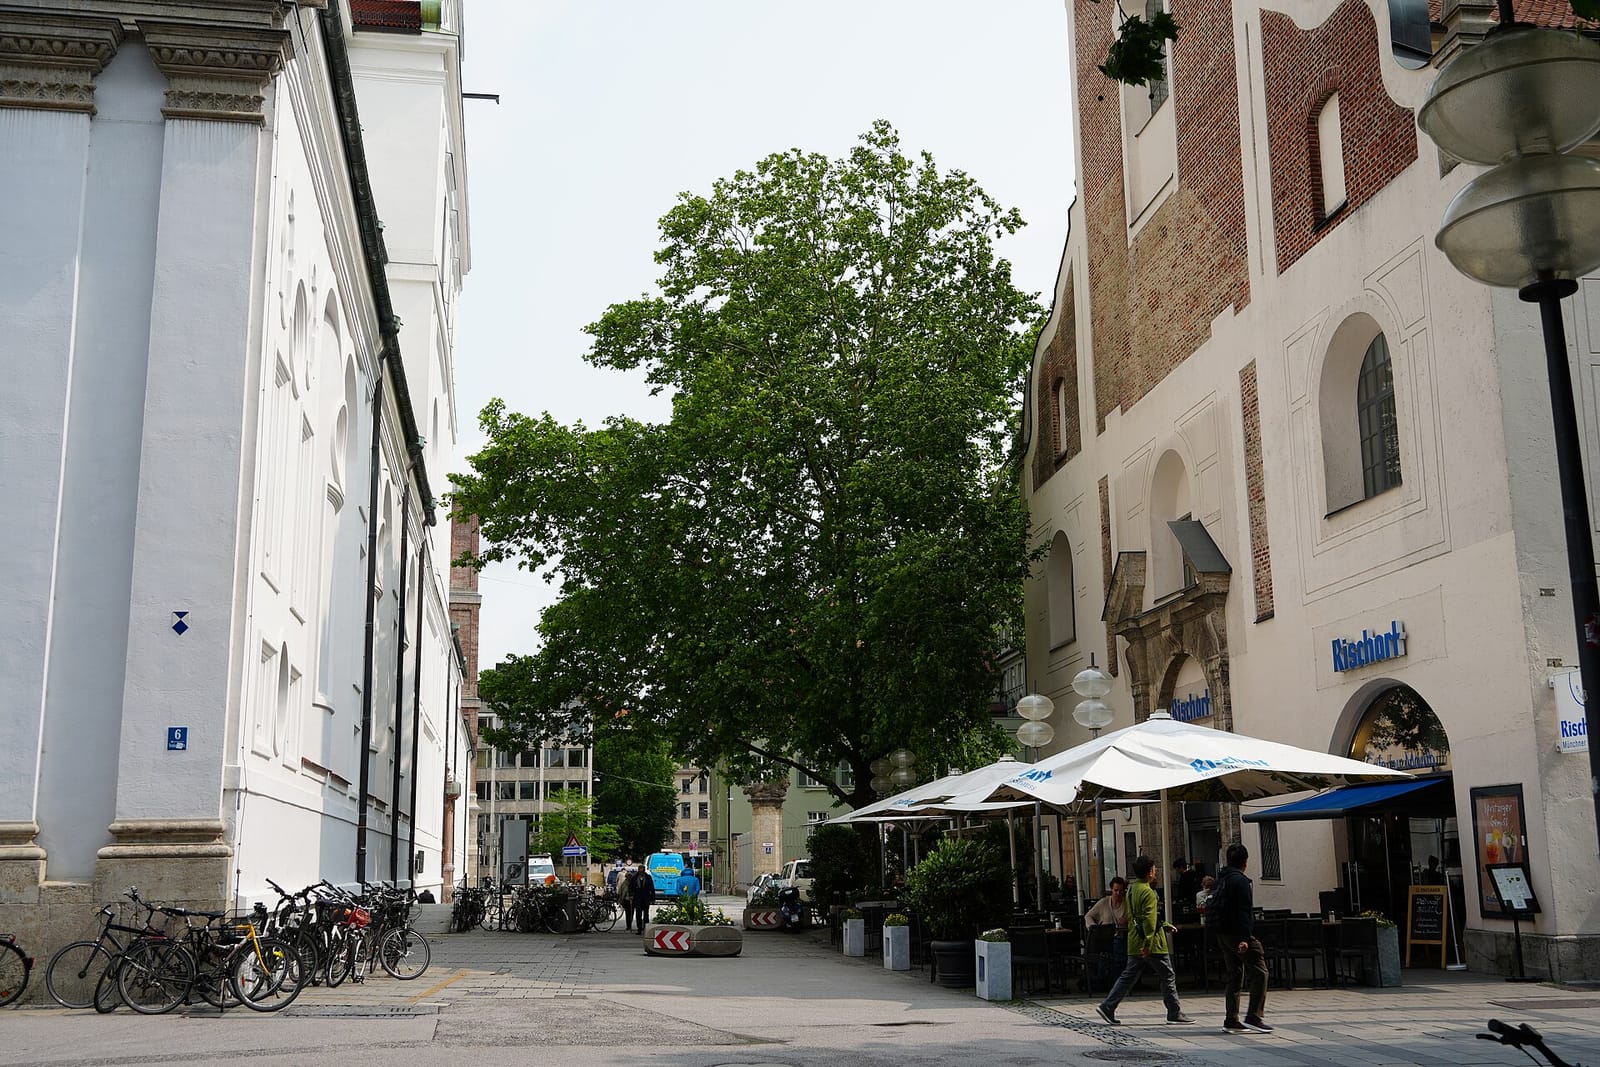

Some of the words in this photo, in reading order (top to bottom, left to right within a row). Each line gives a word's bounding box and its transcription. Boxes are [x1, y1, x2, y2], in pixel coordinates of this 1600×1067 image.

[1332, 620, 1402, 672] Rischart
[1171, 688, 1210, 722] Rischart
[174, 729, 182, 740] 6
[1560, 718, 1587, 738] Risch
